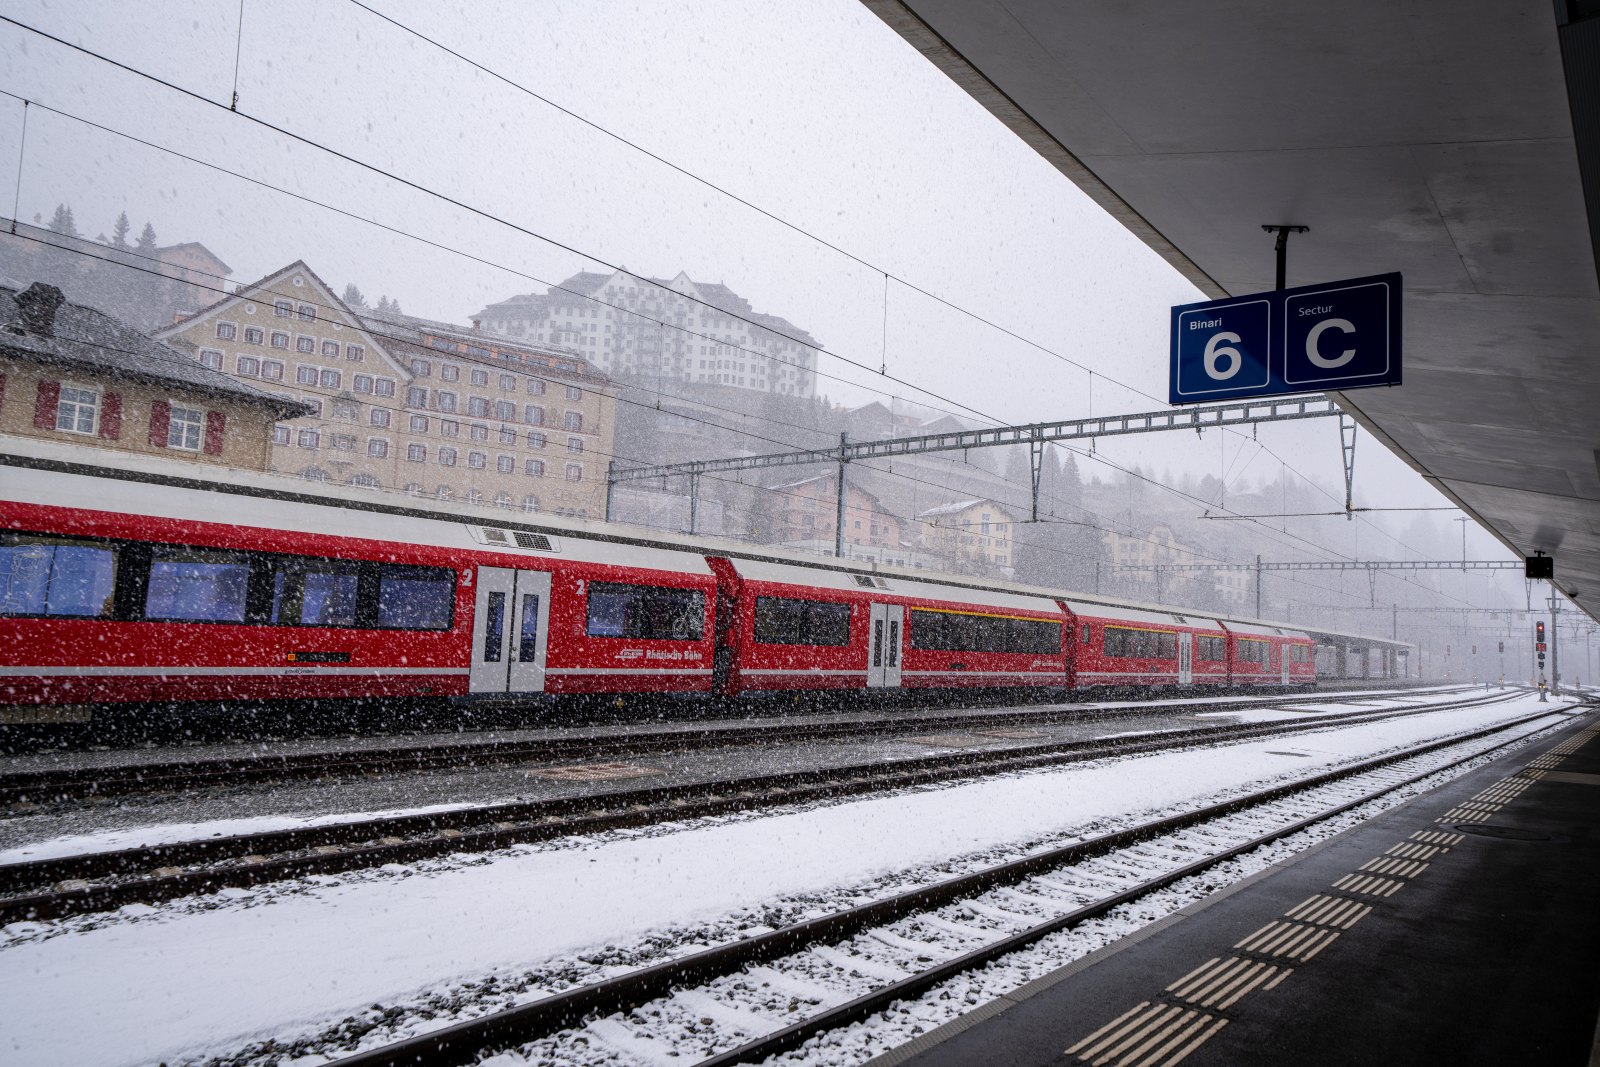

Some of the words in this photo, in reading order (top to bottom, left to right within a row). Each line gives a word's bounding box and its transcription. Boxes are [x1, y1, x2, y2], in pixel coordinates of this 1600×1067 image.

[1298, 305, 1335, 317] Sectur
[1190, 317, 1222, 330] Binari
[1305, 318, 1356, 369] C
[1203, 331, 1242, 381] 6
[462, 568, 473, 587] 2
[575, 579, 585, 595] 2
[684, 650, 702, 660] Bahn
